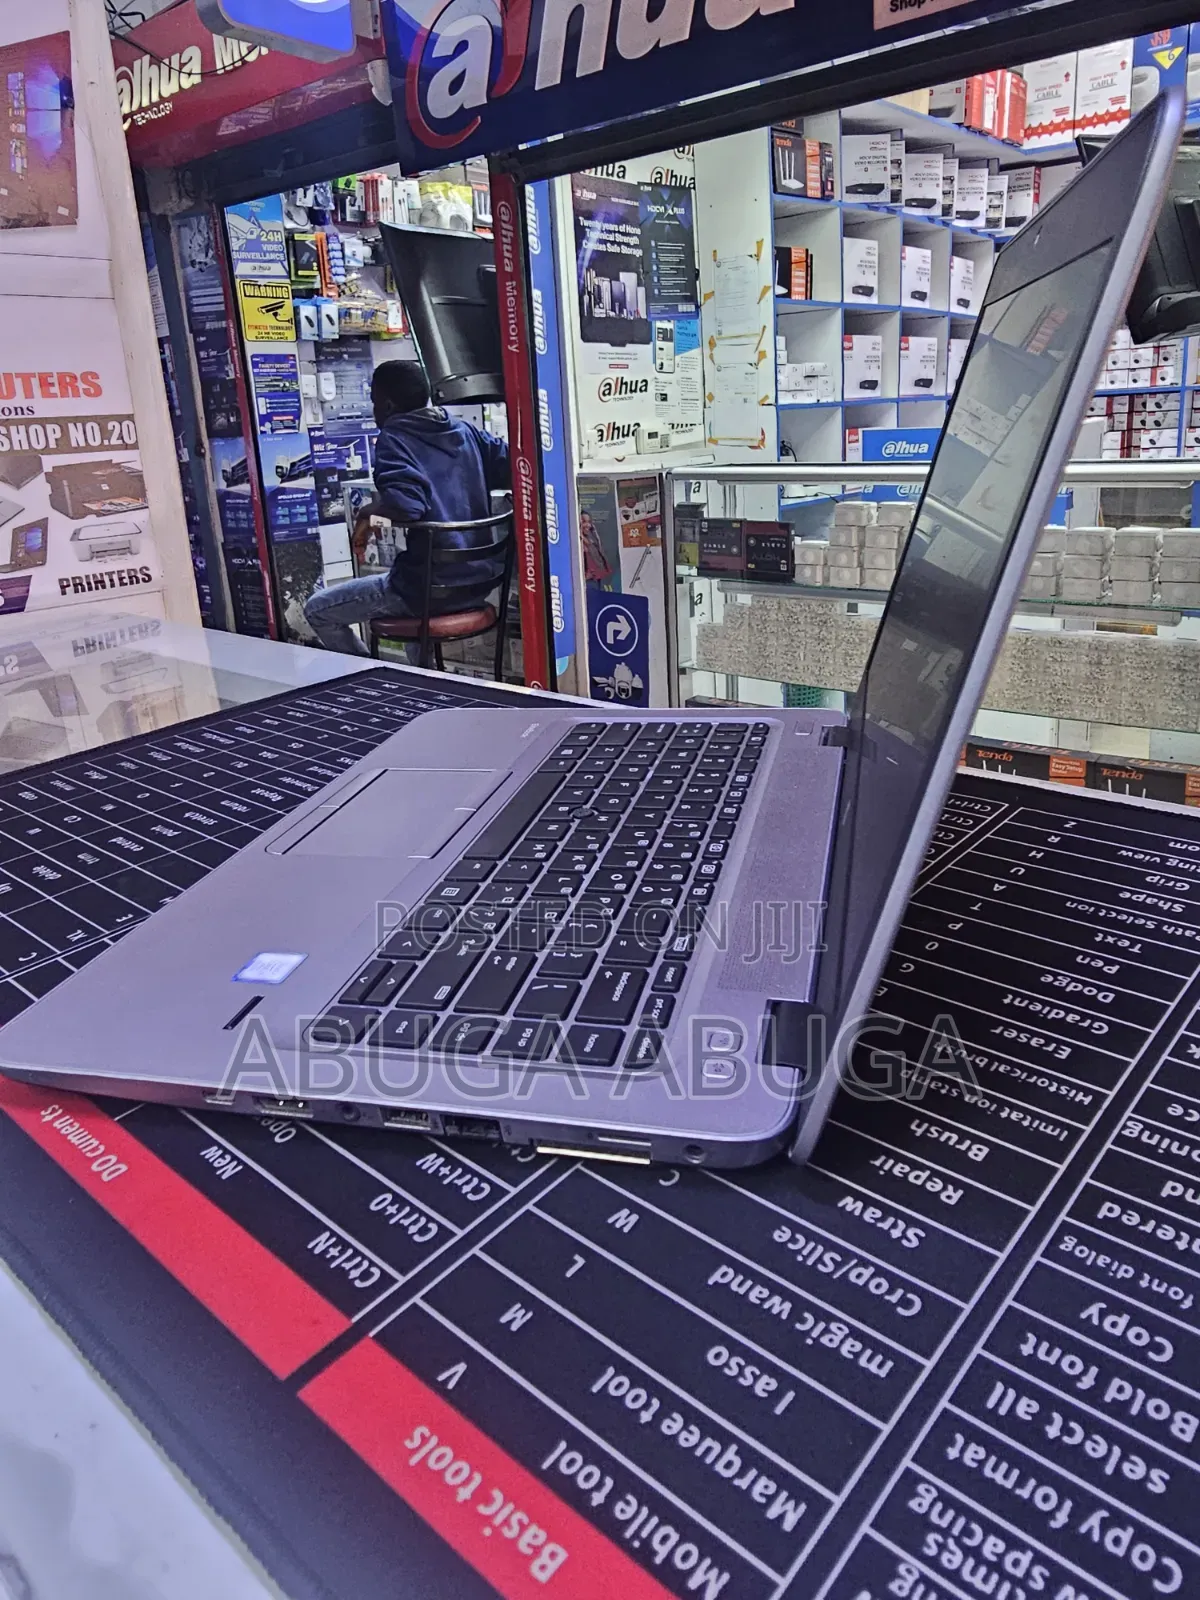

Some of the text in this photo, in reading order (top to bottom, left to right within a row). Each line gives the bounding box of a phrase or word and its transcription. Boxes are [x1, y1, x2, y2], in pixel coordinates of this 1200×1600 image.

[1091, 78, 1116, 89] CABLE
[132, 101, 174, 126] TECHNOLOGY
[259, 230, 283, 242] 24H
[602, 222, 619, 231] years
[261, 243, 284, 252] VIDEO
[615, 232, 640, 245] Strength
[232, 250, 286, 261] SURVEILLANCE
[621, 245, 643, 258] Storage
[244, 284, 290, 299] WARNING
[505, 280, 520, 354] Memory
[0, 420, 138, 451] SHOP NO.20
[604, 440, 627, 448] TECHNOLOGY
[523, 528, 536, 593] Memory
[58, 566, 153, 596] PRINTERS
[977, 749, 1013, 763] Tenda
[1101, 767, 1144, 781] Tenda
[250, 787, 285, 801] Repeat
[220, 799, 252, 813] return
[183, 811, 219, 826] stretch
[1063, 821, 1078, 829] Z
[150, 824, 182, 837] point
[1047, 834, 1062, 844] R
[108, 836, 145, 852] extend
[1029, 850, 1045, 859] H
[77, 853, 101, 864] trim
[1117, 850, 1161, 863] view
[1010, 866, 1026, 876] U
[992, 883, 1008, 893] A
[1145, 875, 1190, 891] Grip
[970, 902, 983, 912] T
[1119, 891, 1187, 913] Shape
[947, 922, 964, 932] P
[1098, 908, 1158, 929] Select
[1094, 932, 1142, 954] Text
[505, 956, 518, 971] enter
[664, 966, 678, 983] insert
[900, 962, 916, 974] G
[1076, 954, 1121, 975] Pen
[612, 971, 632, 1002] backspace
[1039, 973, 1116, 1004] Dodge
[1002, 993, 1110, 1036] Gradient
[395, 1020, 409, 1034] end
[584, 1033, 600, 1053] home
[990, 1025, 1072, 1059] Eraser
[899, 1065, 959, 1098] stamp
[933, 1040, 1094, 1107] Historical brush
[909, 1118, 991, 1162] Brush
[199, 1145, 244, 1180] New
[415, 1152, 492, 1202] Ctrl+W
[869, 1153, 964, 1206] Repair
[606, 1207, 640, 1234] W
[837, 1195, 926, 1249] Straw
[307, 1230, 381, 1288] Ctrl+N
[564, 1253, 587, 1278] L
[772, 1225, 923, 1317] Crop/Slice
[1059, 1235, 1195, 1310] font dialog
[498, 1302, 534, 1332] M
[706, 1264, 895, 1379] magic wand
[1080, 1302, 1175, 1363] Copy
[436, 1361, 468, 1390] V
[706, 1345, 779, 1398] asso
[1019, 1332, 1200, 1443] Bold font
[985, 1381, 1171, 1494] select all
[590, 1366, 808, 1533] Marquee tool
[403, 1424, 570, 1585] Basic tools
[946, 1432, 1184, 1594] Copy format
[541, 1440, 731, 1600] Mobile tool
[907, 1483, 1051, 1591] spacing
